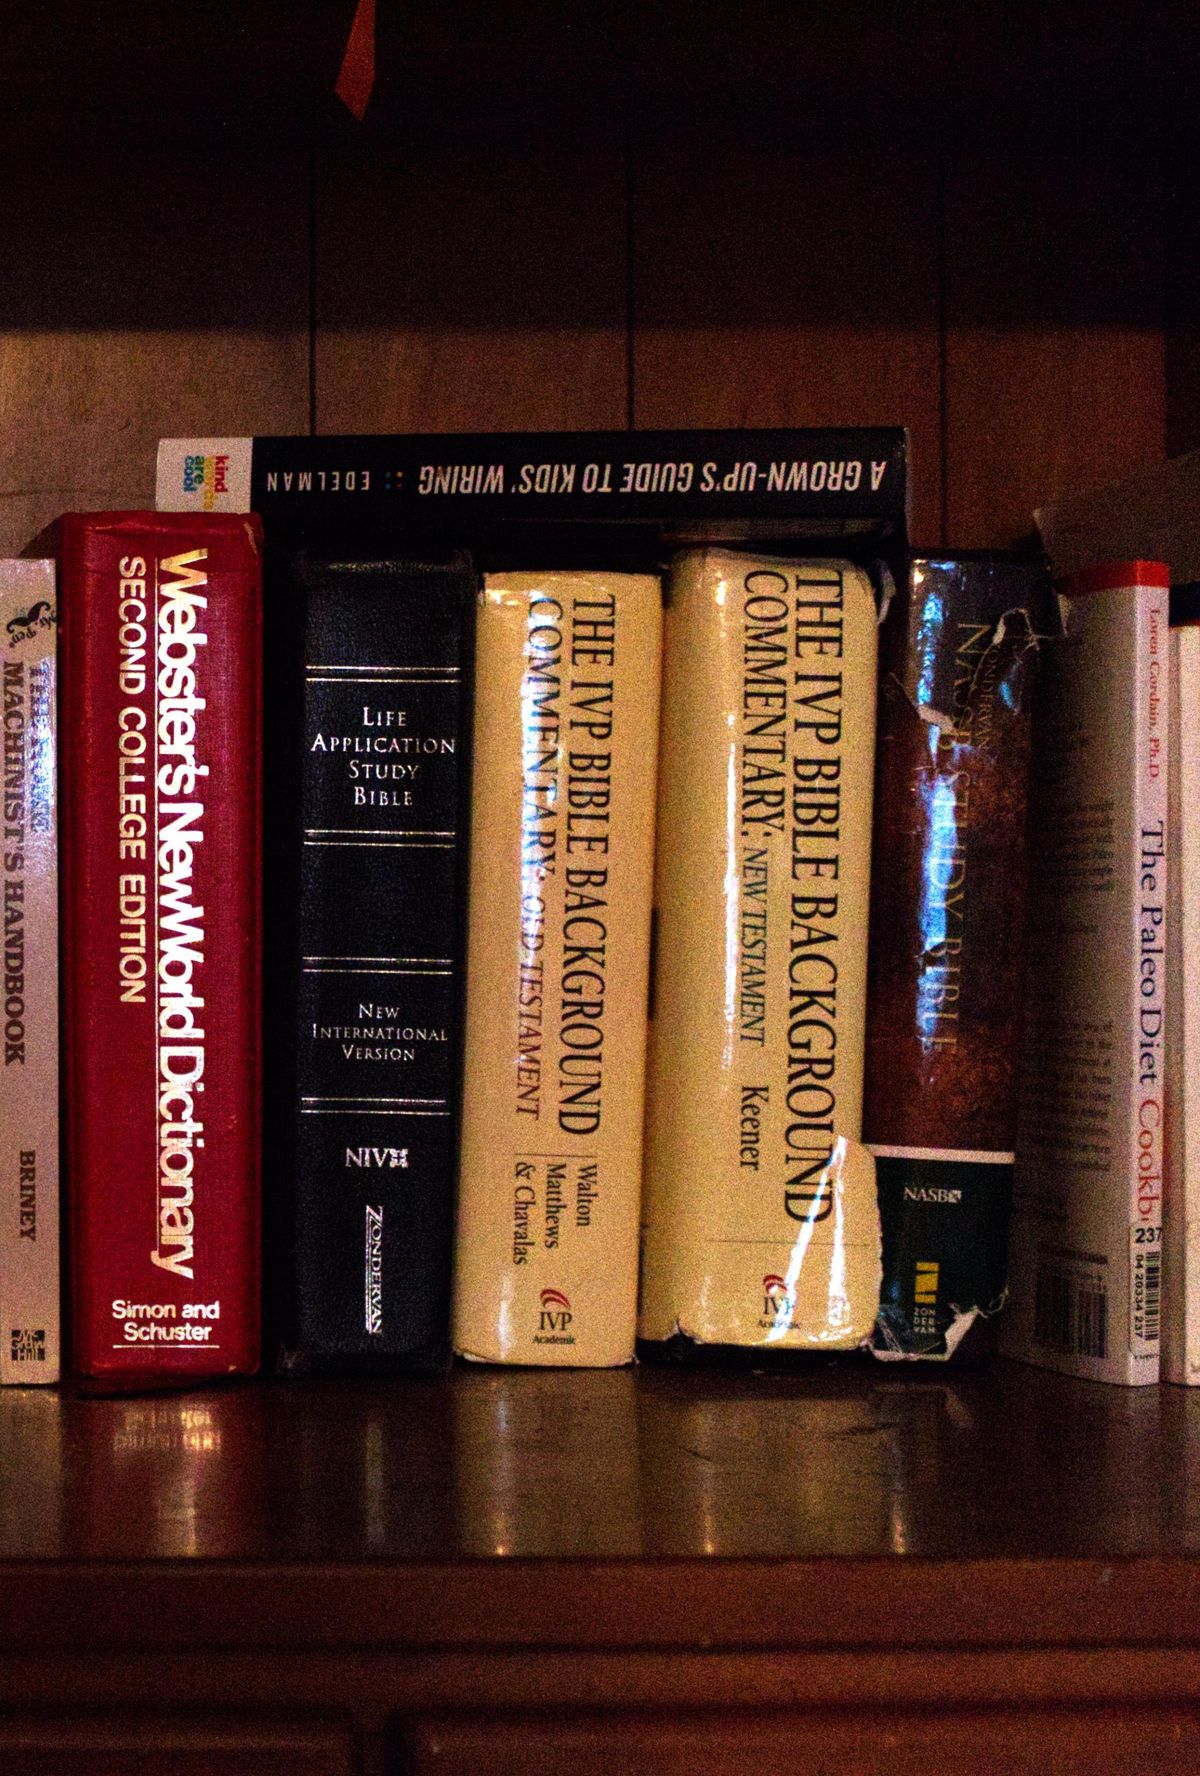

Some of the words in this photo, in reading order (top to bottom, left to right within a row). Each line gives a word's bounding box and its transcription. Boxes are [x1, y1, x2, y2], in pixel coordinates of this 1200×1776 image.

[184, 455, 197, 493] cool
[194, 455, 205, 485] are
[215, 455, 229, 493] kind
[266, 470, 372, 492] EDELMAN
[417, 464, 505, 495] WIRING
[512, 463, 577, 495] KIDS'
[582, 463, 612, 494] TO
[619, 462, 694, 493] GUIDE
[700, 460, 862, 493] GROWN-UP'S
[870, 461, 887, 492] A
[118, 556, 147, 695] SECOND
[570, 593, 616, 667] THE
[795, 570, 844, 659] THE
[157, 547, 210, 796] Webster's
[740, 569, 790, 837] COMMENTARY:
[794, 671, 843, 745] IVP
[569, 680, 614, 741] IVP
[3, 661, 25, 873] MACHINIST'S
[118, 706, 147, 860] COLLEGE
[566, 752, 612, 854] BIBLE
[158, 802, 205, 908] New
[791, 755, 841, 881] BIBLE
[742, 847, 769, 905] NEW
[1140, 820, 1165, 892] The
[119, 874, 147, 1003] EDITION
[522, 894, 546, 952] OLD
[1139, 905, 1164, 998] Paleo
[4, 880, 25, 1066] HANDBOOK
[158, 906, 206, 1039] World
[557, 867, 609, 1135] BACKGROUND
[739, 909, 769, 1047] TESTAMENT
[922, 936, 964, 1055] BIBLE
[516, 960, 544, 1121] TESTAMENT
[784, 892, 839, 1223] BACKGROUND
[1139, 1008, 1163, 1085] Diet
[150, 1046, 205, 1280] Dictionary
[345, 1146, 391, 1168] NIV
[739, 1085, 770, 1172] Keener
[1137, 1099, 1161, 1221] Cookb
[19, 1150, 36, 1241] BRINEY
[514, 1161, 537, 1180] &
[544, 1162, 567, 1250] Matthews
[576, 1162, 598, 1227] Walton
[903, 1186, 950, 1204] NASB
[512, 1185, 537, 1266] Chavalas
[1135, 1227, 1163, 1244] 237
[111, 1300, 177, 1320] Simon
[181, 1300, 221, 1320] and
[123, 1322, 213, 1342] Schuster
[532, 1334, 576, 1346] Academic
[539, 1311, 573, 1332] IVP
